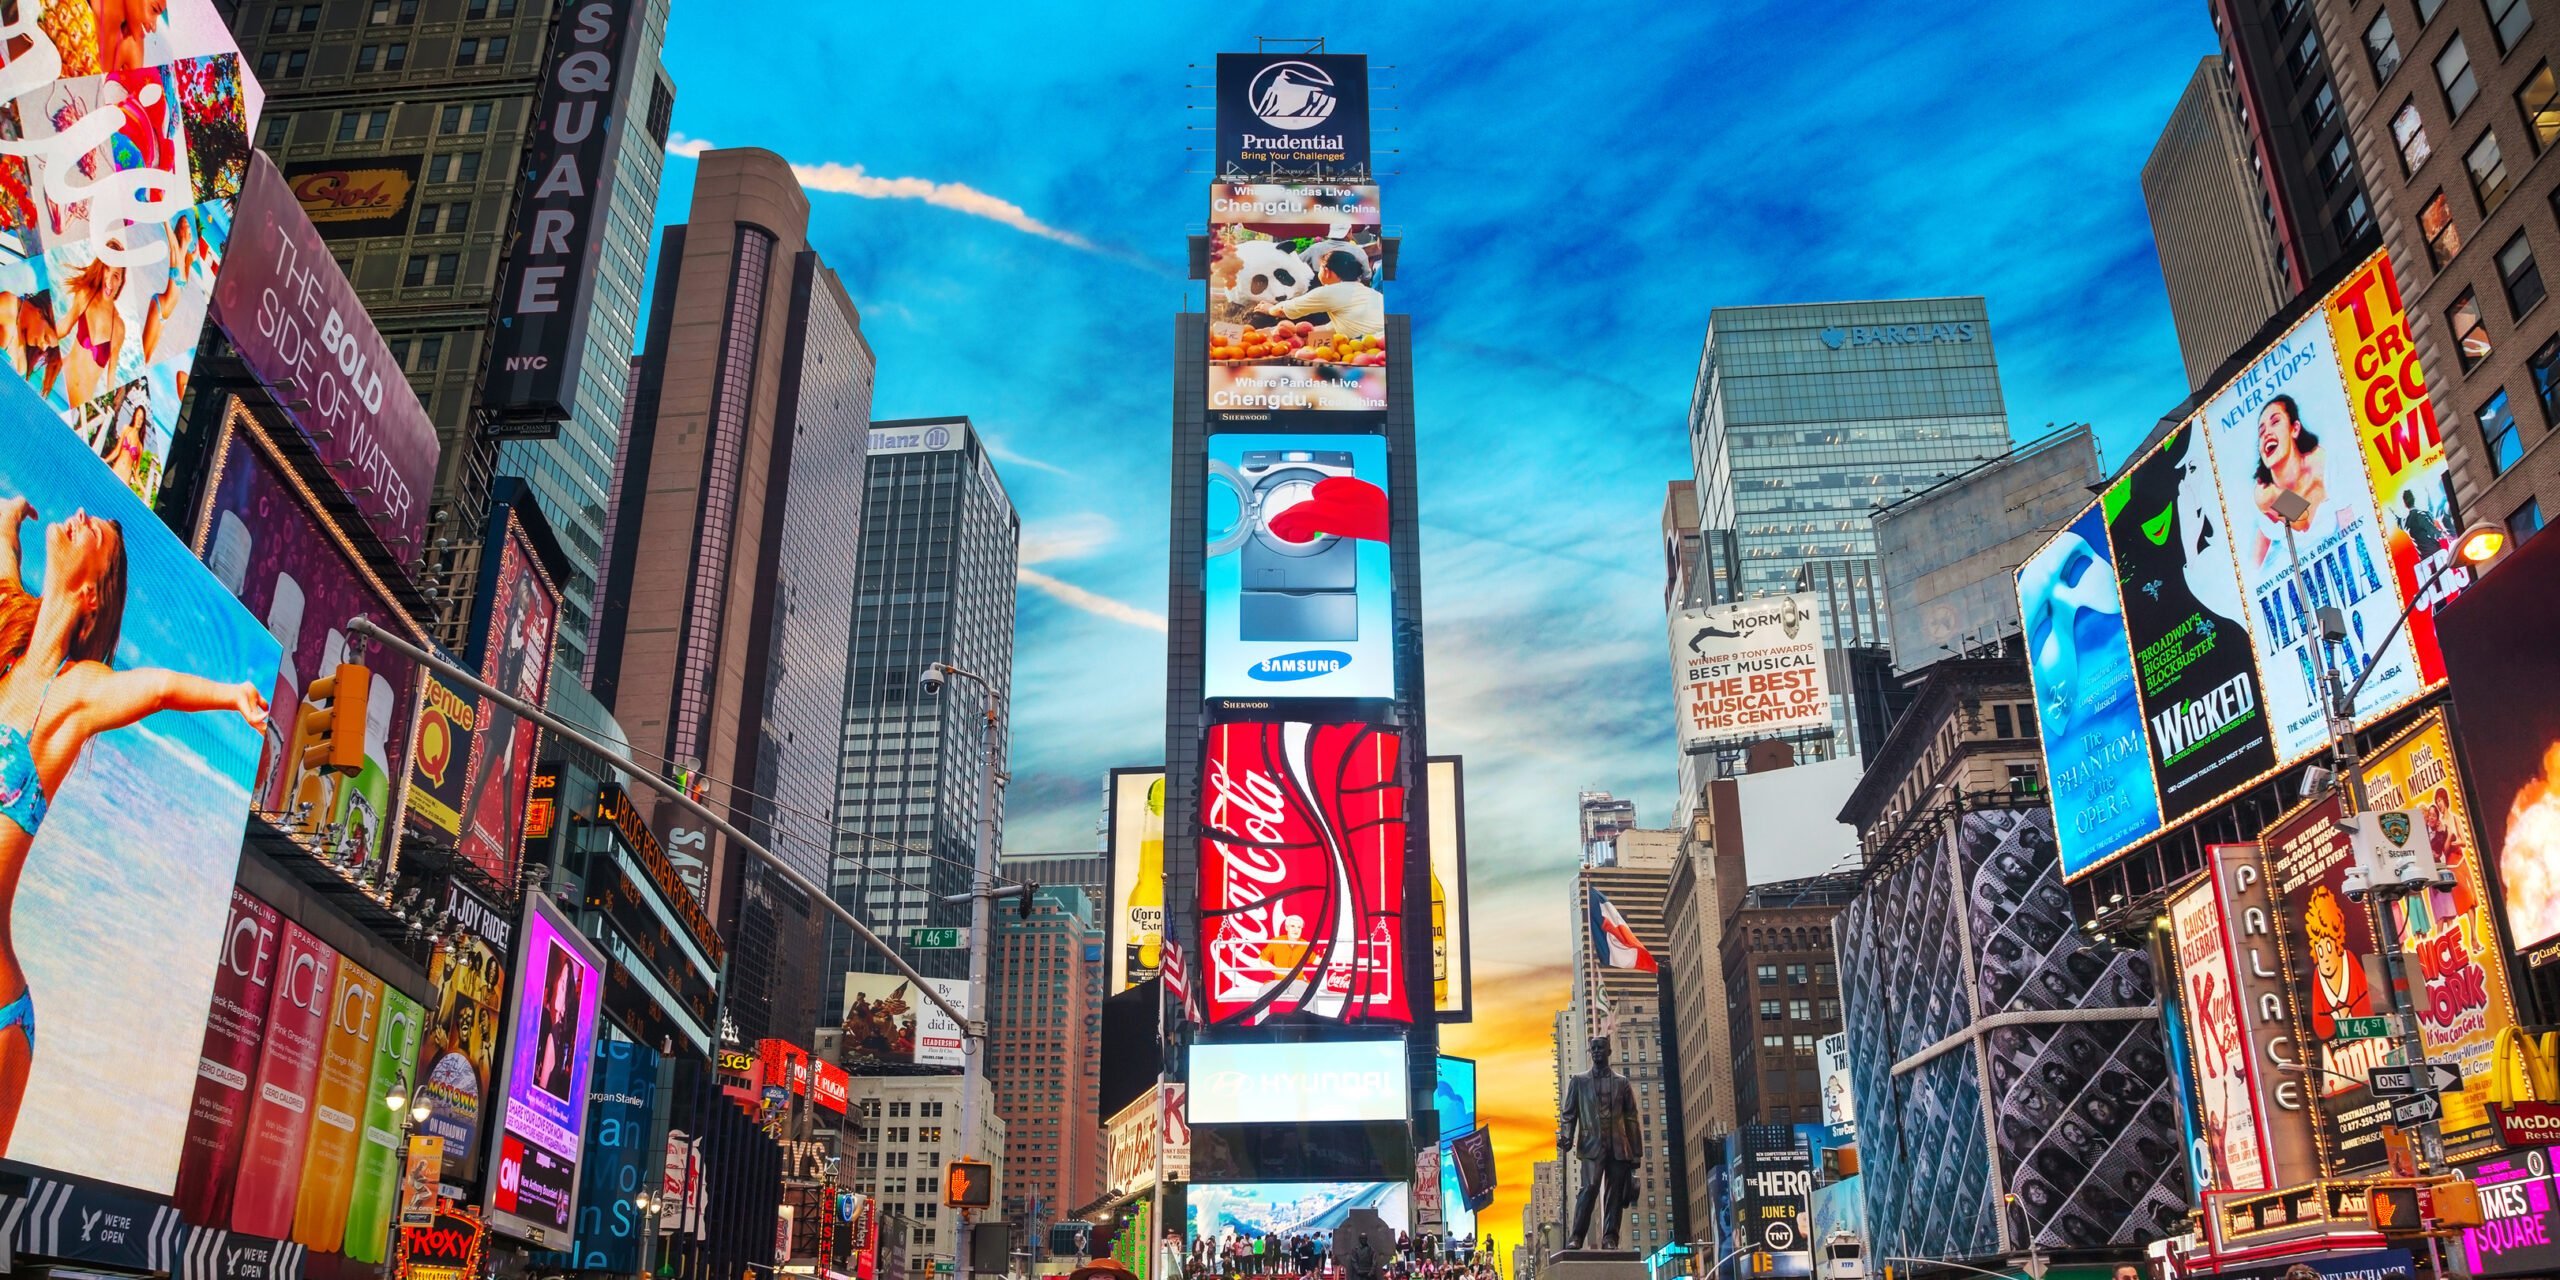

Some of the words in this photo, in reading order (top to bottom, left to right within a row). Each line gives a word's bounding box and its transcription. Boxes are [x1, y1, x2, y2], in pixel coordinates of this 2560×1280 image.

[1241, 134, 1344, 150] Prudential
[516, 3, 613, 314] SQUARE
[1241, 152, 1267, 161] Bring
[1269, 152, 1290, 160] Your
[1293, 152, 1344, 162] Challenges
[1280, 187, 1322, 197] Pandas
[1326, 187, 1354, 197] Live.
[1213, 199, 1307, 215] Chengdu,
[1313, 204, 1339, 213] Real
[1342, 204, 1379, 213] China.
[276, 225, 324, 328] THE
[1852, 323, 1974, 346] BARCLAYS
[321, 307, 383, 416] BOLD
[505, 355, 547, 371] NYC
[2234, 366, 2262, 397] THE
[2263, 339, 2292, 374] FUN
[1235, 378, 1277, 388] Where
[1280, 378, 1328, 388] Pandas
[1331, 378, 1363, 388] Live.
[2221, 388, 2263, 433] NEVER
[2265, 341, 2316, 396] STOPS!
[258, 287, 318, 393] SIDE
[317, 371, 350, 428] OF
[349, 410, 410, 529] WATER
[1213, 391, 1312, 410] Chengdu,
[1222, 413, 1268, 421] SHERWOOD
[868, 433, 919, 450] llianz
[2259, 532, 2383, 656] MAMMA
[1261, 659, 1339, 672] SAMSUNG
[1688, 654, 1729, 667] WINNER
[1731, 653, 1739, 662] 9
[1740, 648, 1769, 660] TONY
[1769, 643, 1814, 656] AWARDS
[1689, 664, 1731, 681] BEST
[1737, 654, 1815, 674] MUSICAL
[2143, 640, 2183, 677] BIGGEST
[2145, 632, 2217, 691] BLOCKBUSTER”
[1683, 677, 1744, 701] “THE
[1749, 668, 1816, 694] BEST
[1223, 700, 1269, 709] SHERWOOD
[1692, 692, 1786, 717] MUSICAL
[1789, 687, 1819, 704] OF
[2093, 690, 2118, 714] Musical
[1694, 714, 1734, 730] THIS
[2287, 722, 2299, 735] THE
[416, 705, 451, 788] Q
[2081, 730, 2103, 752] The
[2057, 729, 2140, 797] PHANTOM
[2410, 744, 2433, 774] Jessie
[2086, 785, 2097, 801] of
[2097, 775, 2115, 795] the
[2408, 758, 2447, 798] MUELLER
[2075, 789, 2131, 834] OPERA
[2297, 815, 2331, 845] ULTIMATE
[2276, 842, 2312, 873] FEEL-GOOD
[2290, 864, 2298, 876] IS
[2298, 851, 2317, 872] BACK
[2317, 842, 2333, 859] AND
[2389, 850, 2416, 858] SECURITY
[2283, 872, 2307, 894] BETTER
[2306, 860, 2326, 879] THAN
[232, 890, 277, 924] SPARKLING
[457, 896, 483, 931] JOY
[481, 909, 511, 951] RIDE!
[219, 907, 274, 987] ICE
[293, 928, 331, 959] SPARKLING
[914, 931, 923, 946] W
[926, 931, 941, 946] 46
[944, 930, 954, 939] ST
[281, 943, 329, 1018] ICE
[343, 961, 378, 988] SPARKLING
[938, 984, 952, 998] By
[2236, 865, 2300, 1110] PALACE
[227, 1000, 262, 1027] Raspberry
[334, 975, 376, 1042] ICE
[389, 991, 419, 1015] SPARKLING
[273, 1022, 287, 1037] Pink
[927, 1019, 946, 1031] did
[947, 1021, 957, 1031] it.
[1084, 966, 1099, 1076] NOVOTEL
[2337, 1021, 2350, 1037] W
[2353, 1020, 2369, 1036] 46
[2371, 1018, 2382, 1028] ST
[2426, 1031, 2435, 1048] If
[2434, 1028, 2449, 1045] You
[2449, 1023, 2464, 1044] Can
[2462, 1017, 2477, 1035] Get
[2476, 1015, 2486, 1030] It
[381, 1003, 417, 1067] ICE
[923, 1038, 959, 1048] LEADERSHIP
[200, 1062, 215, 1074] ZERO
[215, 1068, 245, 1086] CALORIES
[2322, 1037, 2390, 1099] Annie
[822, 1077, 845, 1099] PLAZA
[1260, 1071, 1394, 1094] HYUNDAI
[2380, 1075, 2406, 1087] ONE
[265, 1086, 279, 1099] ZERO
[279, 1093, 304, 1110] CALORIES
[427, 1080, 477, 1113] MOTOWN
[615, 1093, 644, 1109] Stanley
[2337, 1099, 2392, 1124] TICKETMASTER.COM
[2400, 1107, 2414, 1120] ONE
[2418, 1099, 2435, 1115] WAY
[429, 1117, 440, 1133] ON
[439, 1119, 468, 1143] BROADWAY
[2340, 1122, 2348, 1133] OR
[1110, 1124, 1134, 1196] Kinky
[1132, 1113, 1158, 1179] Boots
[1746, 1178, 1758, 1186] THE
[1757, 1170, 1812, 1197] HERO
[104, 1213, 132, 1230] WE'RE
[1761, 1205, 1786, 1218] JUNE
[1788, 1205, 1795, 1217] 6
[2233, 1211, 2255, 1231] Annie
[2263, 1207, 2287, 1225] Annie
[100, 1229, 125, 1245] OPEN
[407, 1227, 473, 1259] ROXY
[1769, 1231, 1789, 1240] TNT
[2476, 1213, 2551, 1255] SQUARE
[243, 1247, 268, 1263] WE'RE
[240, 1263, 262, 1278] OPEN
